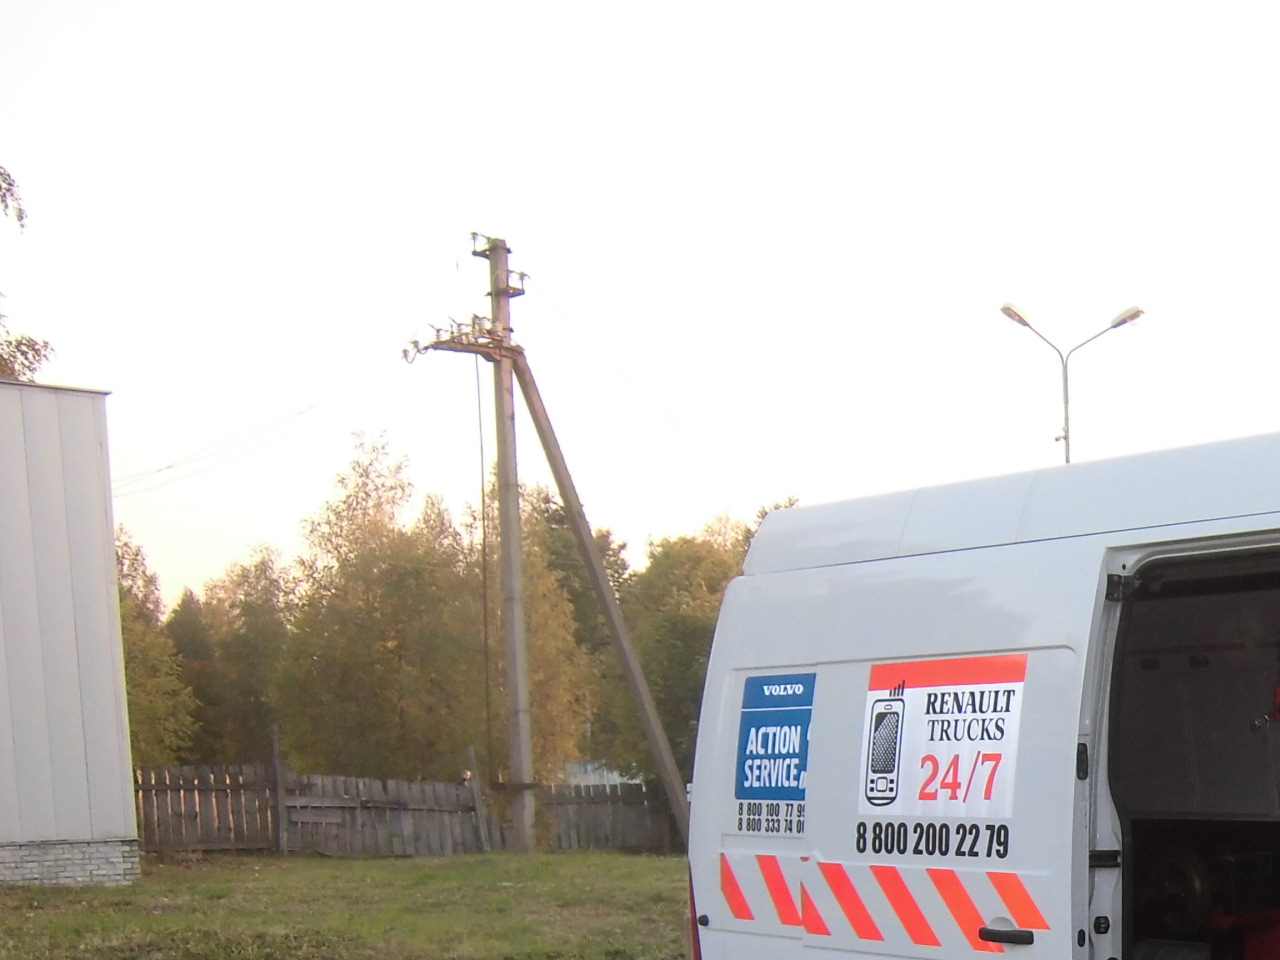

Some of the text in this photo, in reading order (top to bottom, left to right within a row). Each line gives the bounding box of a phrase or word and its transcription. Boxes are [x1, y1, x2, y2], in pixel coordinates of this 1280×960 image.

[763, 684, 804, 696] VOLVO
[925, 689, 1016, 715] RENAULT
[745, 725, 801, 755] ACTION
[928, 717, 1006, 742] TRUCKS
[743, 757, 800, 788] SERVICE
[918, 750, 1003, 803] 24/7
[738, 802, 744, 816] 8
[746, 802, 762, 817] 800
[765, 802, 780, 817] 100
[785, 803, 794, 818] 77
[737, 817, 743, 832] 8
[746, 817, 762, 832] 800
[764, 818, 781, 833] 333
[784, 818, 793, 833] 74
[856, 821, 1010, 859] 8 800 200 22 79
